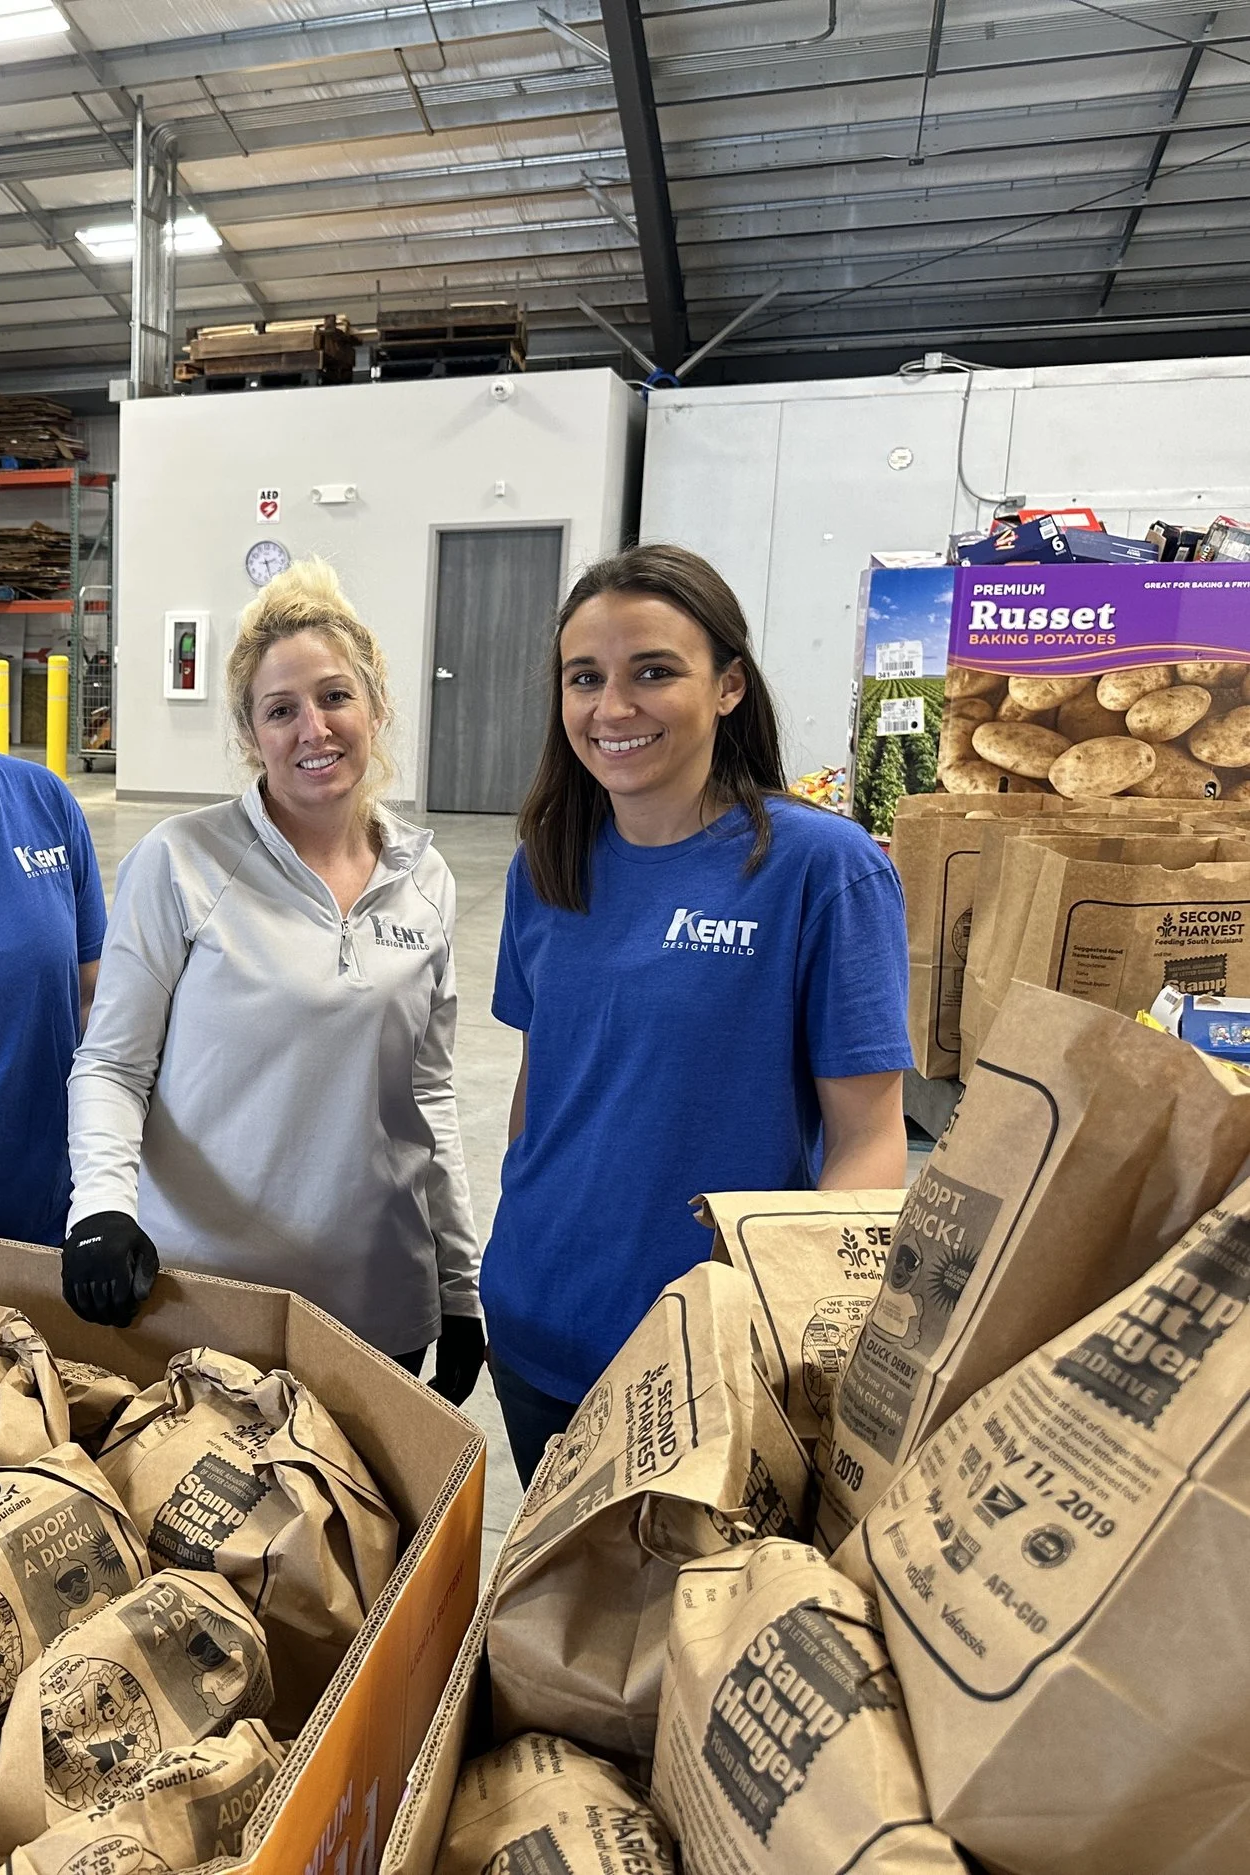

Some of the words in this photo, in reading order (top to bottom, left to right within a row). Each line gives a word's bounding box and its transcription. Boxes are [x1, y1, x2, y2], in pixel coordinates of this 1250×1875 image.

[260, 491, 279, 499] AED
[1051, 535, 1064, 553] 6
[973, 584, 1045, 596] PREMIUM
[1232, 580, 1250, 588] FRYI
[968, 600, 1117, 631] Russet
[969, 634, 1029, 645] BAKING
[1033, 634, 1116, 645] POTATOES
[13, 845, 66, 873] KENT
[370, 914, 425, 944] KENT
[665, 908, 759, 946] KENT
[1178, 923, 1246, 938] HARVEST
[1179, 911, 1242, 924] SECOND
[375, 938, 404, 949] DESIGN
[406, 943, 430, 951] BUILD
[662, 940, 708, 952] DESIGN
[712, 944, 755, 956] BUILD
[1154, 938, 1185, 947] Feeding
[1187, 937, 1209, 946] South
[1210, 936, 1244, 945] Louisiana
[1165, 977, 1228, 998] Stamp
[920, 1176, 966, 1216] DOPT
[908, 1204, 966, 1250] DUCK!
[844, 1270, 883, 1281] Feedin
[867, 1339, 891, 1363] DUCK
[892, 1354, 918, 1381] DERBY
[1086, 1352, 1159, 1405] DRIVE
[657, 1380, 678, 1457] SECOND
[220, 1431, 248, 1452] Feeding
[1055, 1435, 1093, 1467] Second
[837, 1448, 864, 1492] 2019
[1048, 1451, 1097, 1497] community
[178, 1473, 246, 1527] Stamp
[179, 1499, 220, 1531] Out
[1023, 1461, 1055, 1498] 11,
[1055, 1488, 1117, 1539] 2019
[21, 1505, 78, 1553] ADOPT
[157, 1503, 222, 1551] Hunger
[24, 1560, 40, 1579] A
[39, 1523, 96, 1568] DUCK!
[155, 1531, 177, 1551] FOOD
[176, 1543, 209, 1564] DRIVE
[681, 1588, 697, 1610] Cereal
[984, 1573, 1048, 1635] AFL-CIO
[788, 1626, 816, 1660] LETTER
[50, 1659, 71, 1679] NEED
[747, 1625, 845, 1738] Stamp
[746, 1676, 803, 1750] Out
[713, 1674, 806, 1794] Hunger
[146, 1770, 188, 1793] South
[710, 1729, 736, 1775] FOOD
[732, 1760, 769, 1816] DRIVE
[217, 1777, 266, 1830] ADOPT
[69, 1856, 88, 1872] WE
[94, 1838, 123, 1858] NEED
[115, 1844, 140, 1860] JOIN
